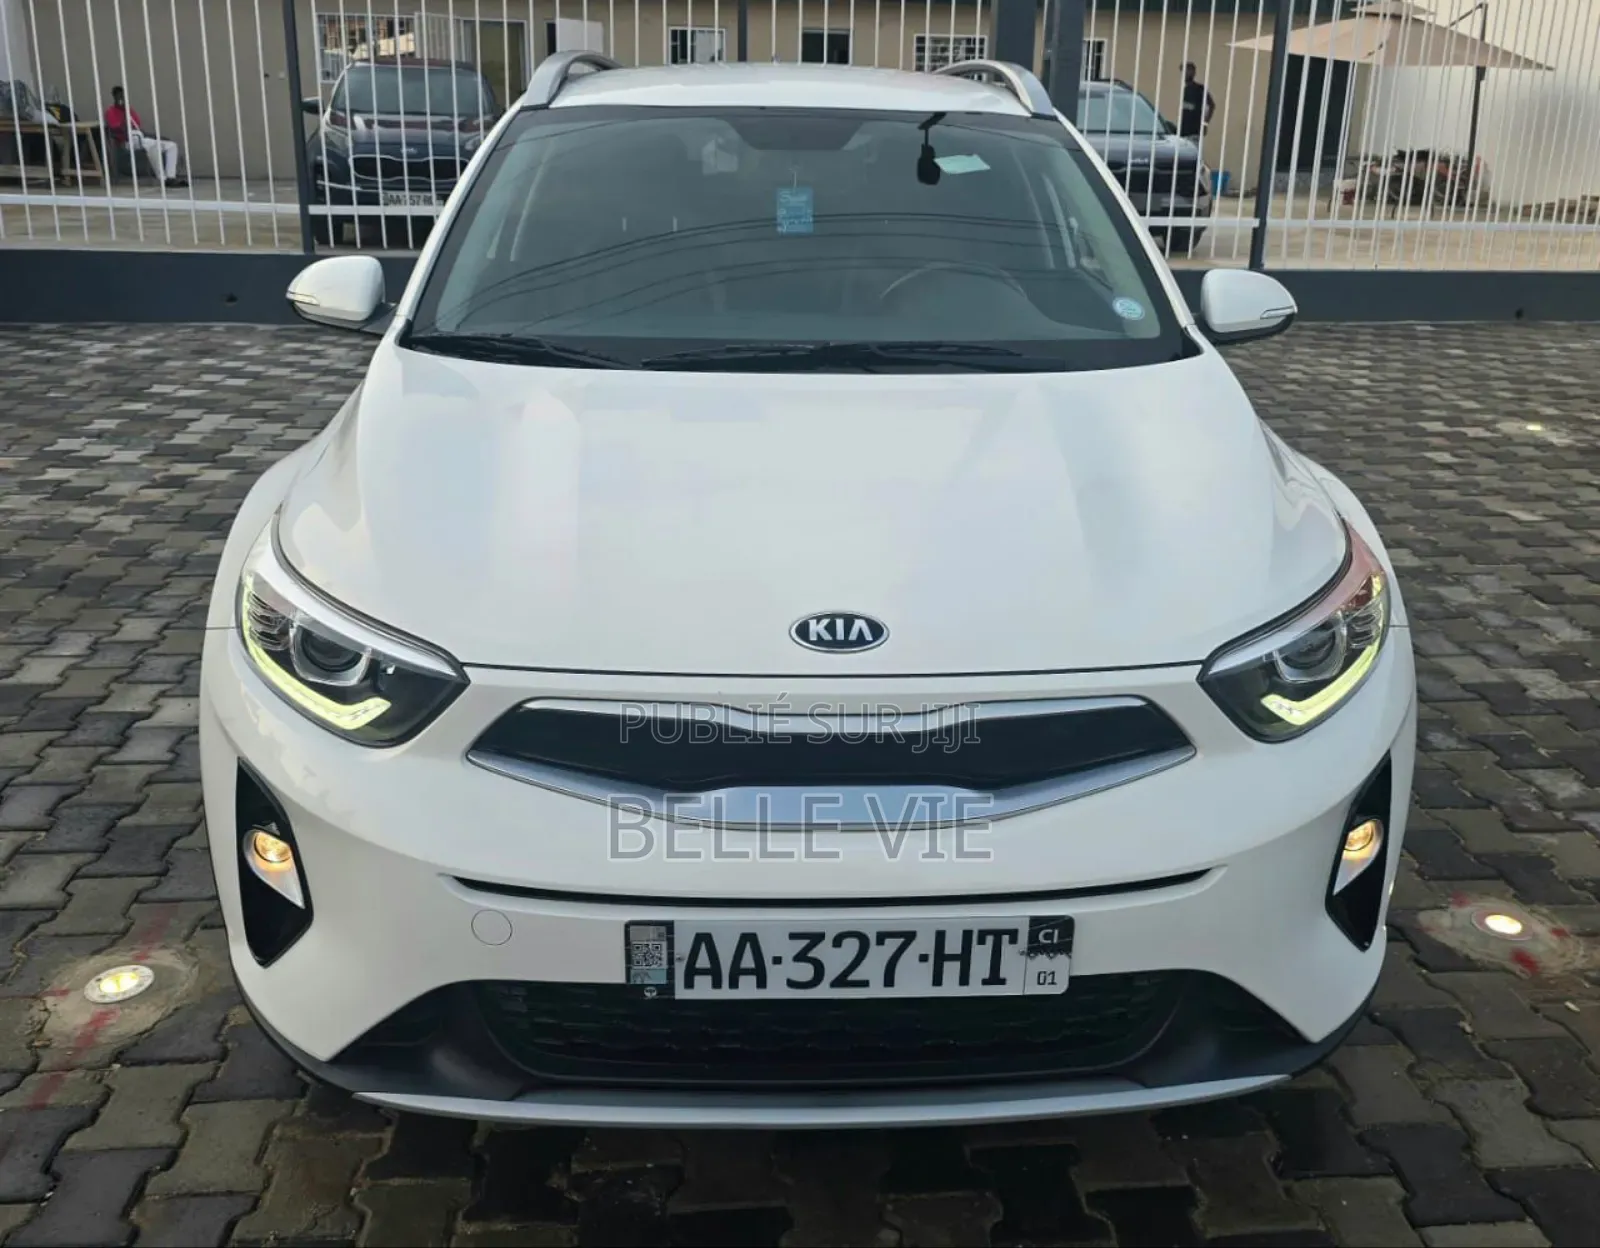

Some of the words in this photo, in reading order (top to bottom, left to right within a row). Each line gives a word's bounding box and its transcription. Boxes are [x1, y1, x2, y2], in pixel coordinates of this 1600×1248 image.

[807, 618, 874, 641] KIA
[1038, 929, 1058, 944] CI
[1037, 970, 1058, 986] 01
